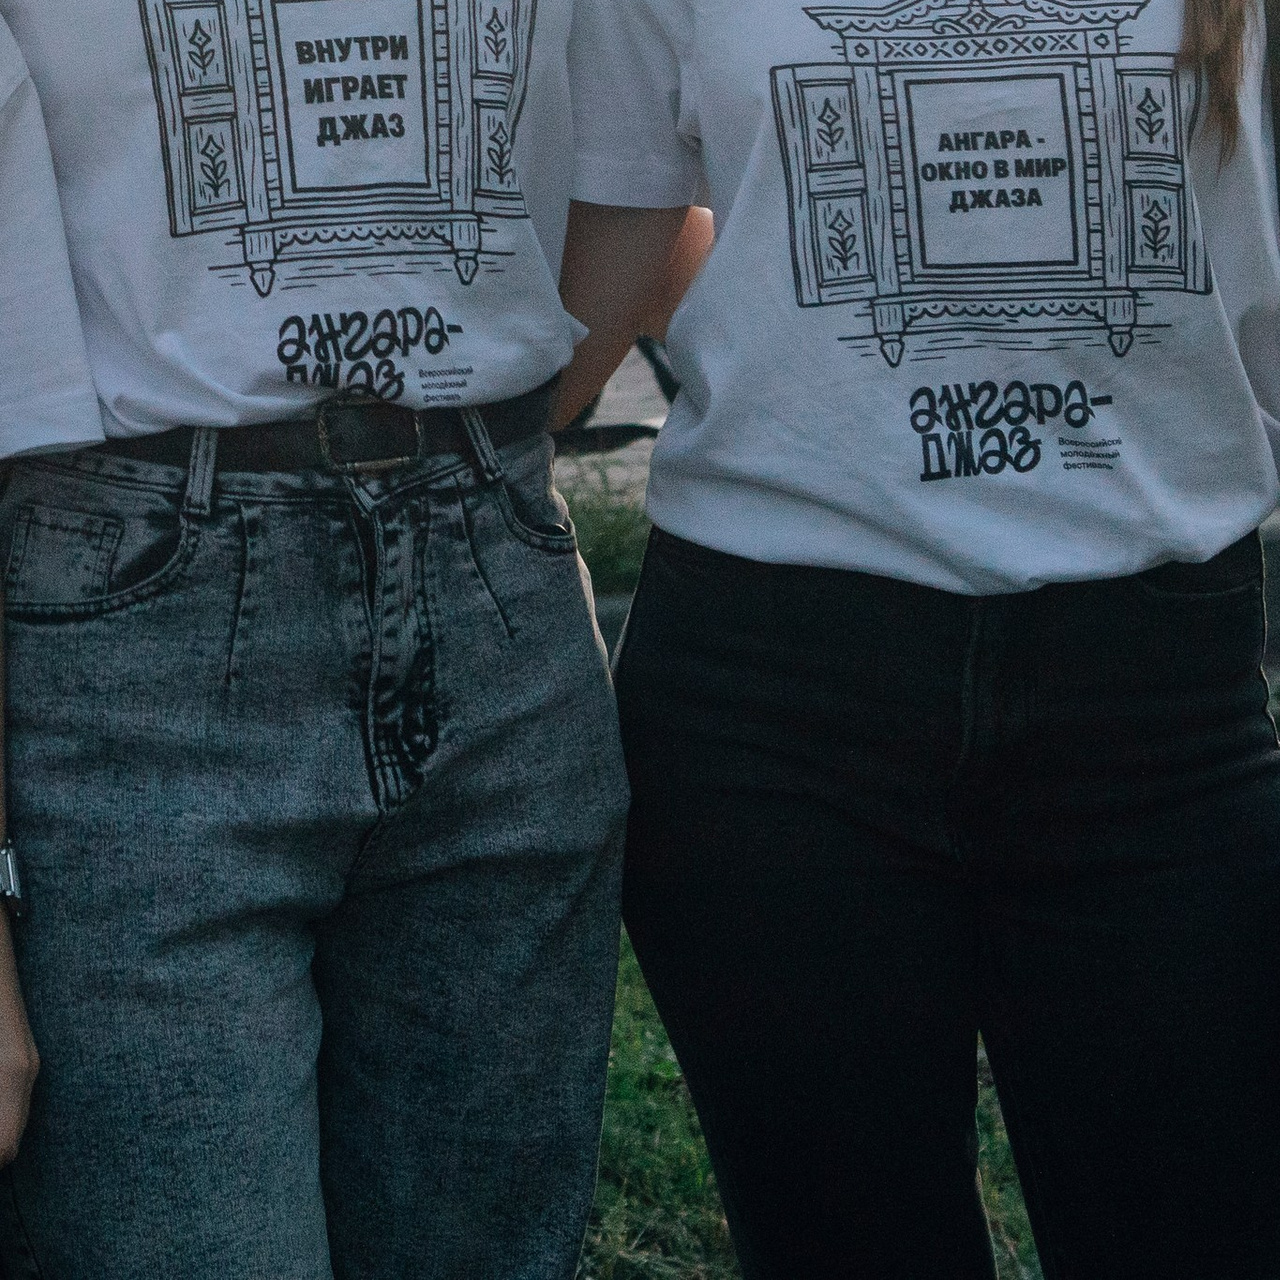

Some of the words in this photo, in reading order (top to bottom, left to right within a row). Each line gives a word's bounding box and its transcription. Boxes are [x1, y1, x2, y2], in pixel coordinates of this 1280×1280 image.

[295, 35, 409, 65] ВНУТРИ
[303, 74, 408, 105] ИГРАЕТ
[316, 113, 405, 147] ДЖАЗ
[938, 129, 1032, 152] АНГАРА
[921, 160, 989, 182] ОКНО
[994, 159, 1010, 179] В
[1014, 157, 1067, 178] МИР
[949, 187, 1043, 213] ДЖАЗА
[1058, 436, 1123, 448] Всероссийский
[1063, 460, 1114, 471] фестиваль
